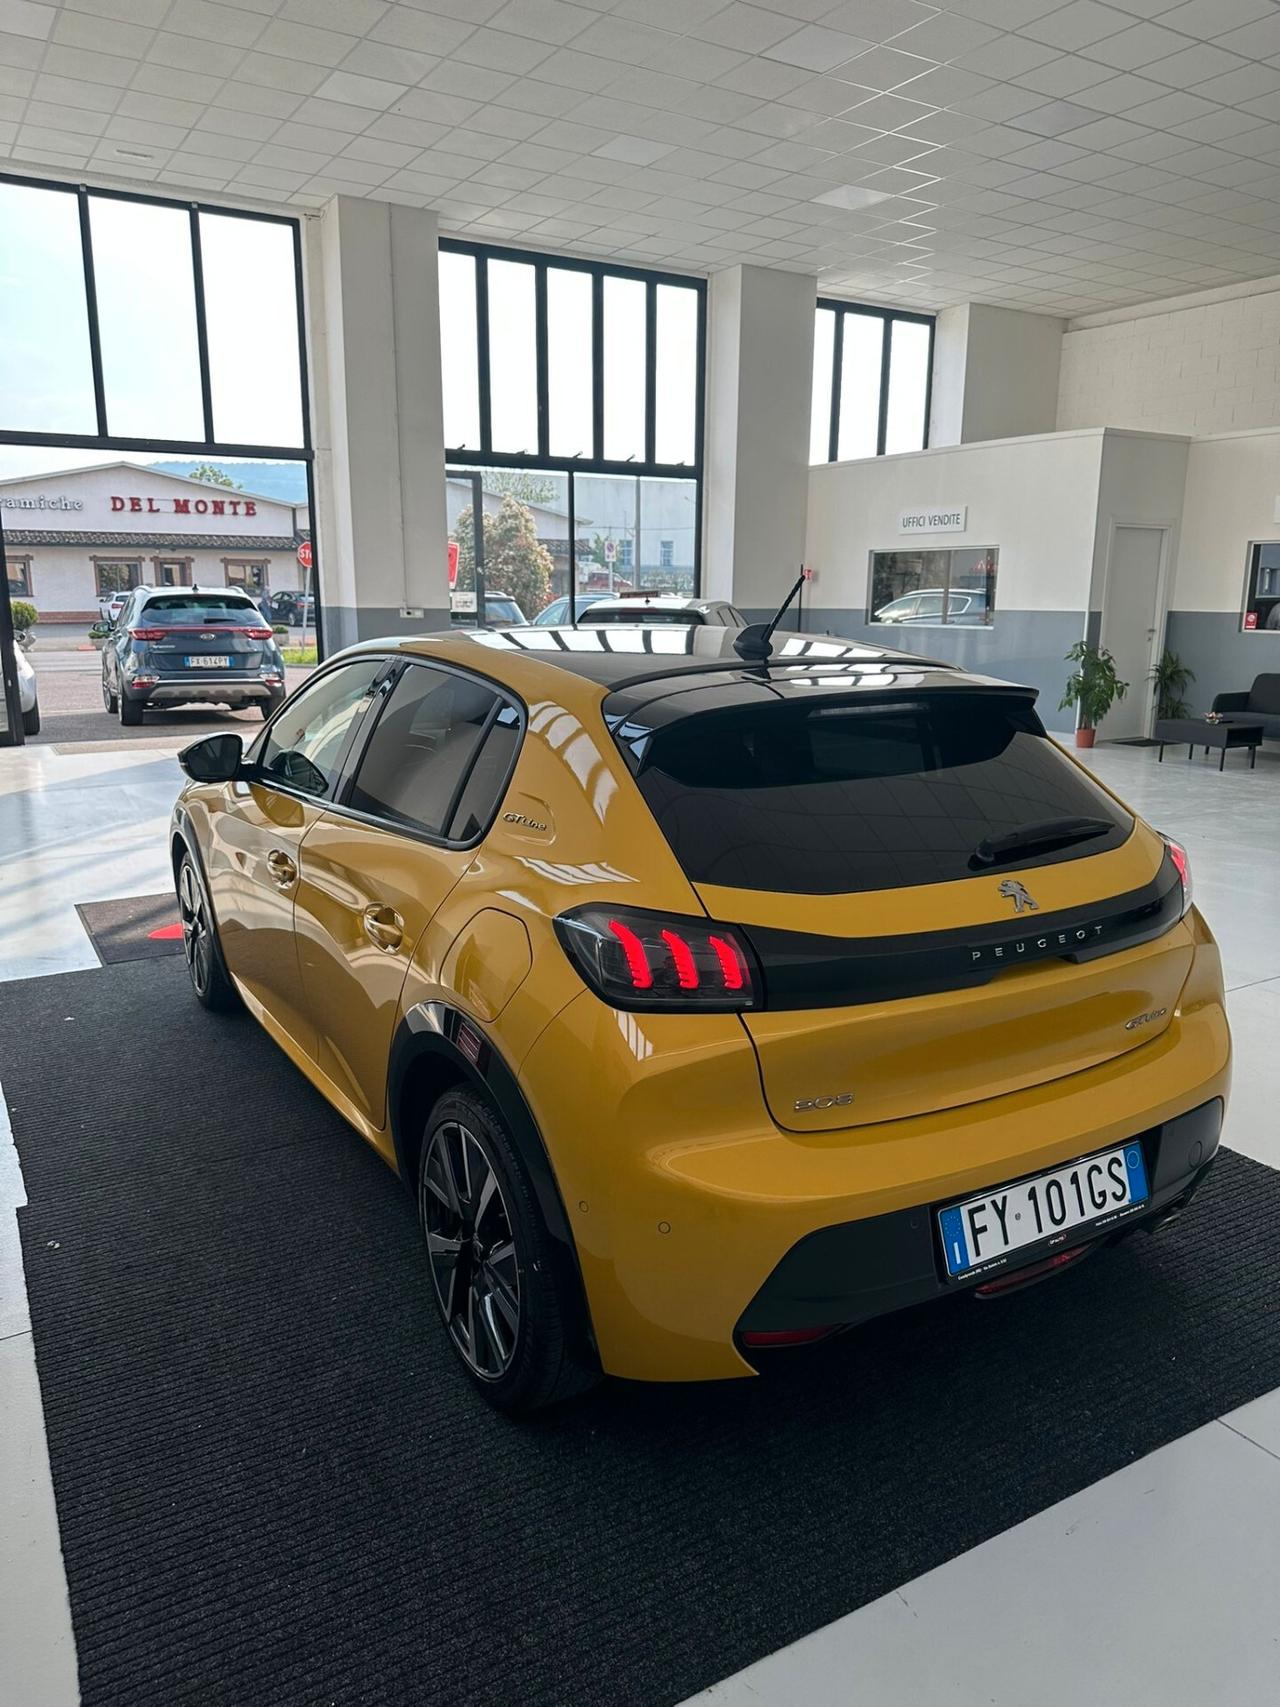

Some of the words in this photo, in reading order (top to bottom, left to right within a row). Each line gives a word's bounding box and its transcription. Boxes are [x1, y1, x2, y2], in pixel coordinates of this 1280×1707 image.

[0, 495, 83, 510] amiche
[110, 496, 160, 513] DEL
[173, 498, 257, 516] MONTE
[902, 515, 926, 528] UFFICI
[928, 513, 961, 526] VENDITE
[300, 549, 312, 559] ST
[972, 925, 1103, 961] PEUGEOT
[967, 1195, 1010, 1257] FY
[1027, 1157, 1127, 1234] 101GS
